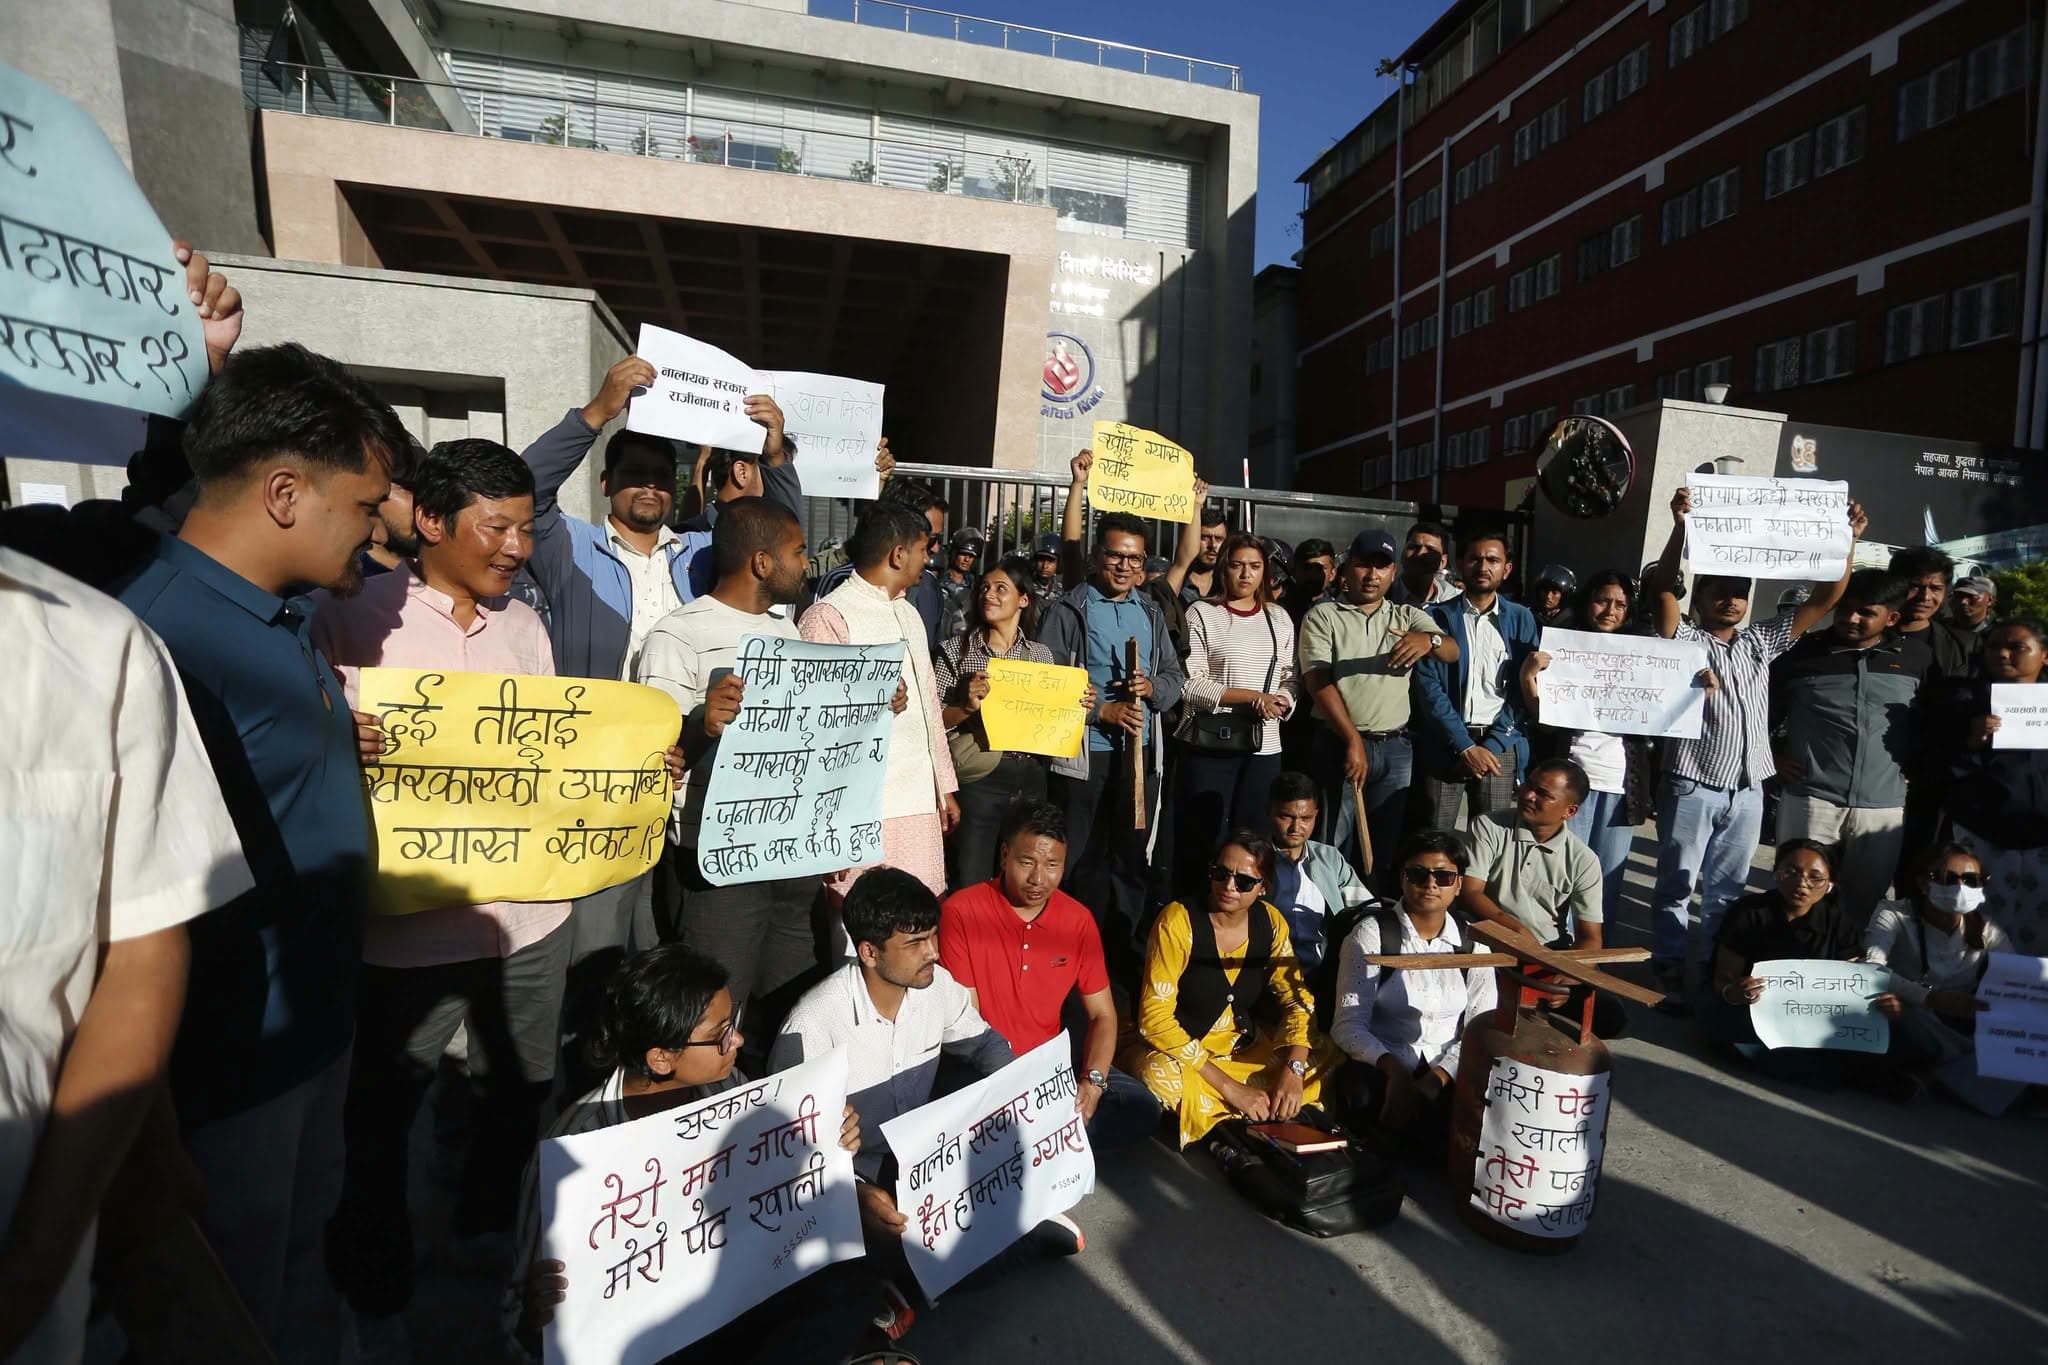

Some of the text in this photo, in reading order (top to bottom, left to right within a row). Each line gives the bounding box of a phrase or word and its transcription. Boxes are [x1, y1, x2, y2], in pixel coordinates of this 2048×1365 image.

[661, 366, 709, 386] नालायक
[713, 379, 748, 396] सरकार
[669, 390, 720, 410] राजीनामा
[1145, 441, 1180, 463] ग्यास
[1914, 462, 1934, 476] नेपाल
[1937, 468, 1959, 479] आयल
[1923, 452, 1950, 465] सहजता,
[1097, 485, 1161, 511] सरकार
[1691, 509, 1840, 540] जनतामा ग्यासको
[737, 638, 787, 689] तिम्रो
[791, 645, 872, 696] सुशासनको
[377, 674, 444, 757] दुई
[739, 690, 795, 732] महंगी
[797, 706, 811, 732] र
[361, 747, 552, 806] सरकारको
[733, 732, 883, 778] ग्यासको संकट र
[716, 778, 848, 826] जनताको हत्या
[393, 827, 531, 864] ग्यास
[1494, 1067, 1599, 1118] मेरो पेट
[910, 1131, 963, 1191] बालेन
[968, 1090, 1034, 1154] सरकार
[1032, 1117, 1085, 1168] ग्यास
[1511, 1120, 1591, 1154] खाली
[589, 1094, 821, 1250] तेरो मन जाली
[1485, 1145, 1540, 1189] तेरो
[603, 1151, 826, 1300] मेरो पेट खाली
[1485, 1184, 1594, 1231] पेट खाली
